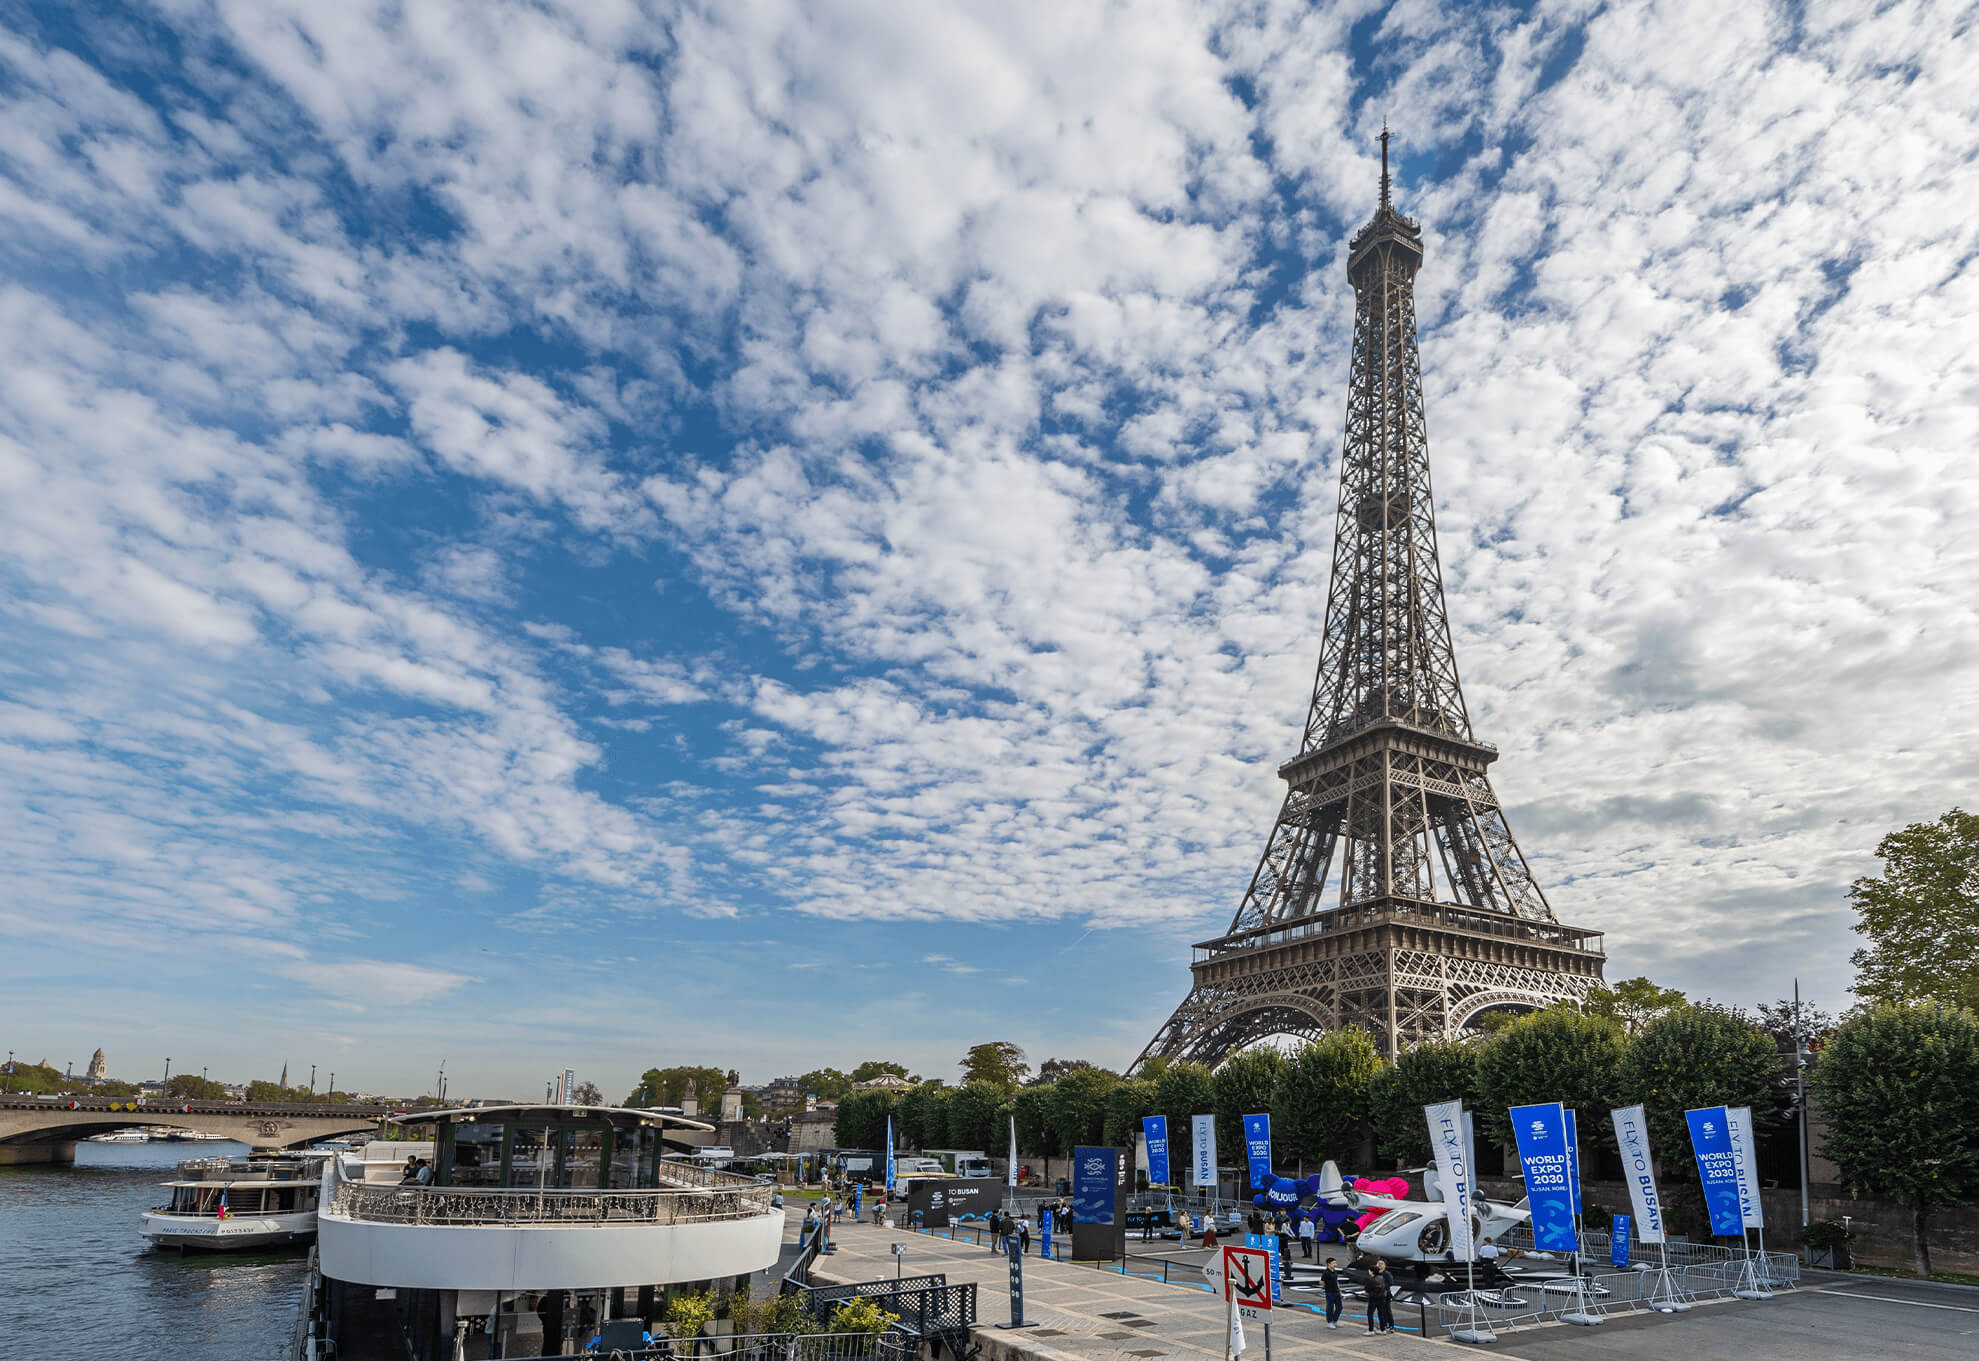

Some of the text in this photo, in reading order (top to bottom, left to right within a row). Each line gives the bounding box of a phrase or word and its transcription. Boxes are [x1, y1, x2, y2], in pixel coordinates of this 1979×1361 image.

[1200, 1138, 1207, 1149] TO
[1440, 1119, 1458, 1147] FLY
[1451, 1152, 1464, 1177] TO
[1524, 1154, 1565, 1165] WORLD
[1698, 1151, 1733, 1161] WORLD
[1201, 1151, 1209, 1180] BUSAN
[1531, 1164, 1562, 1174] EXPO
[1705, 1160, 1732, 1169] EXPO
[1624, 1121, 1659, 1231] FLY TO BUSAN
[1708, 1168, 1734, 1178] 2030
[1533, 1174, 1564, 1184] 2030
[957, 1187, 979, 1195] BUSAN
[1268, 1188, 1299, 1202] BONJOUR
[1206, 1268, 1215, 1276] 50
[1240, 1308, 1257, 1319] GAZ
